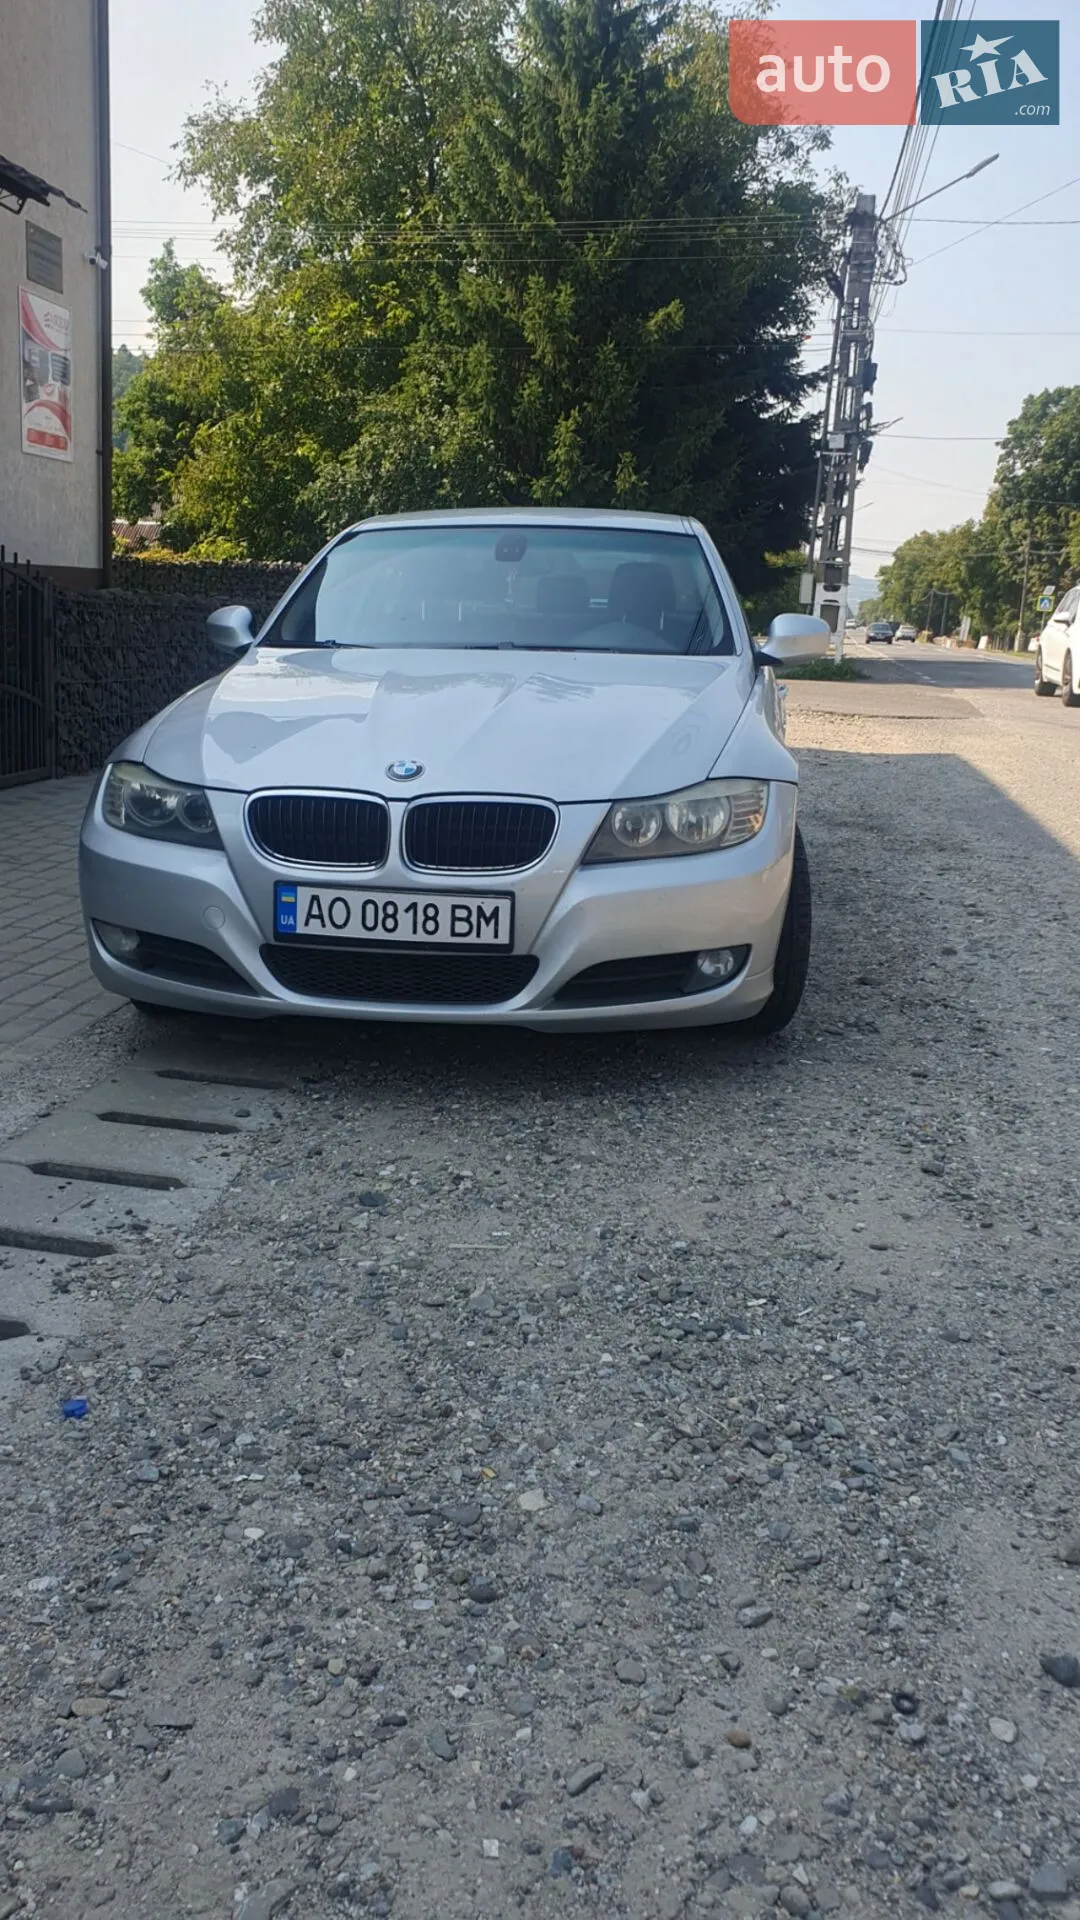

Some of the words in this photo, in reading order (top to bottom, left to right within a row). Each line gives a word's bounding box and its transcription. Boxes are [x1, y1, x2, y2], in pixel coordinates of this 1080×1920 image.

[280, 914, 295, 926] UA
[303, 894, 351, 930] AO
[361, 899, 440, 936] 0818
[450, 904, 500, 940] BM
